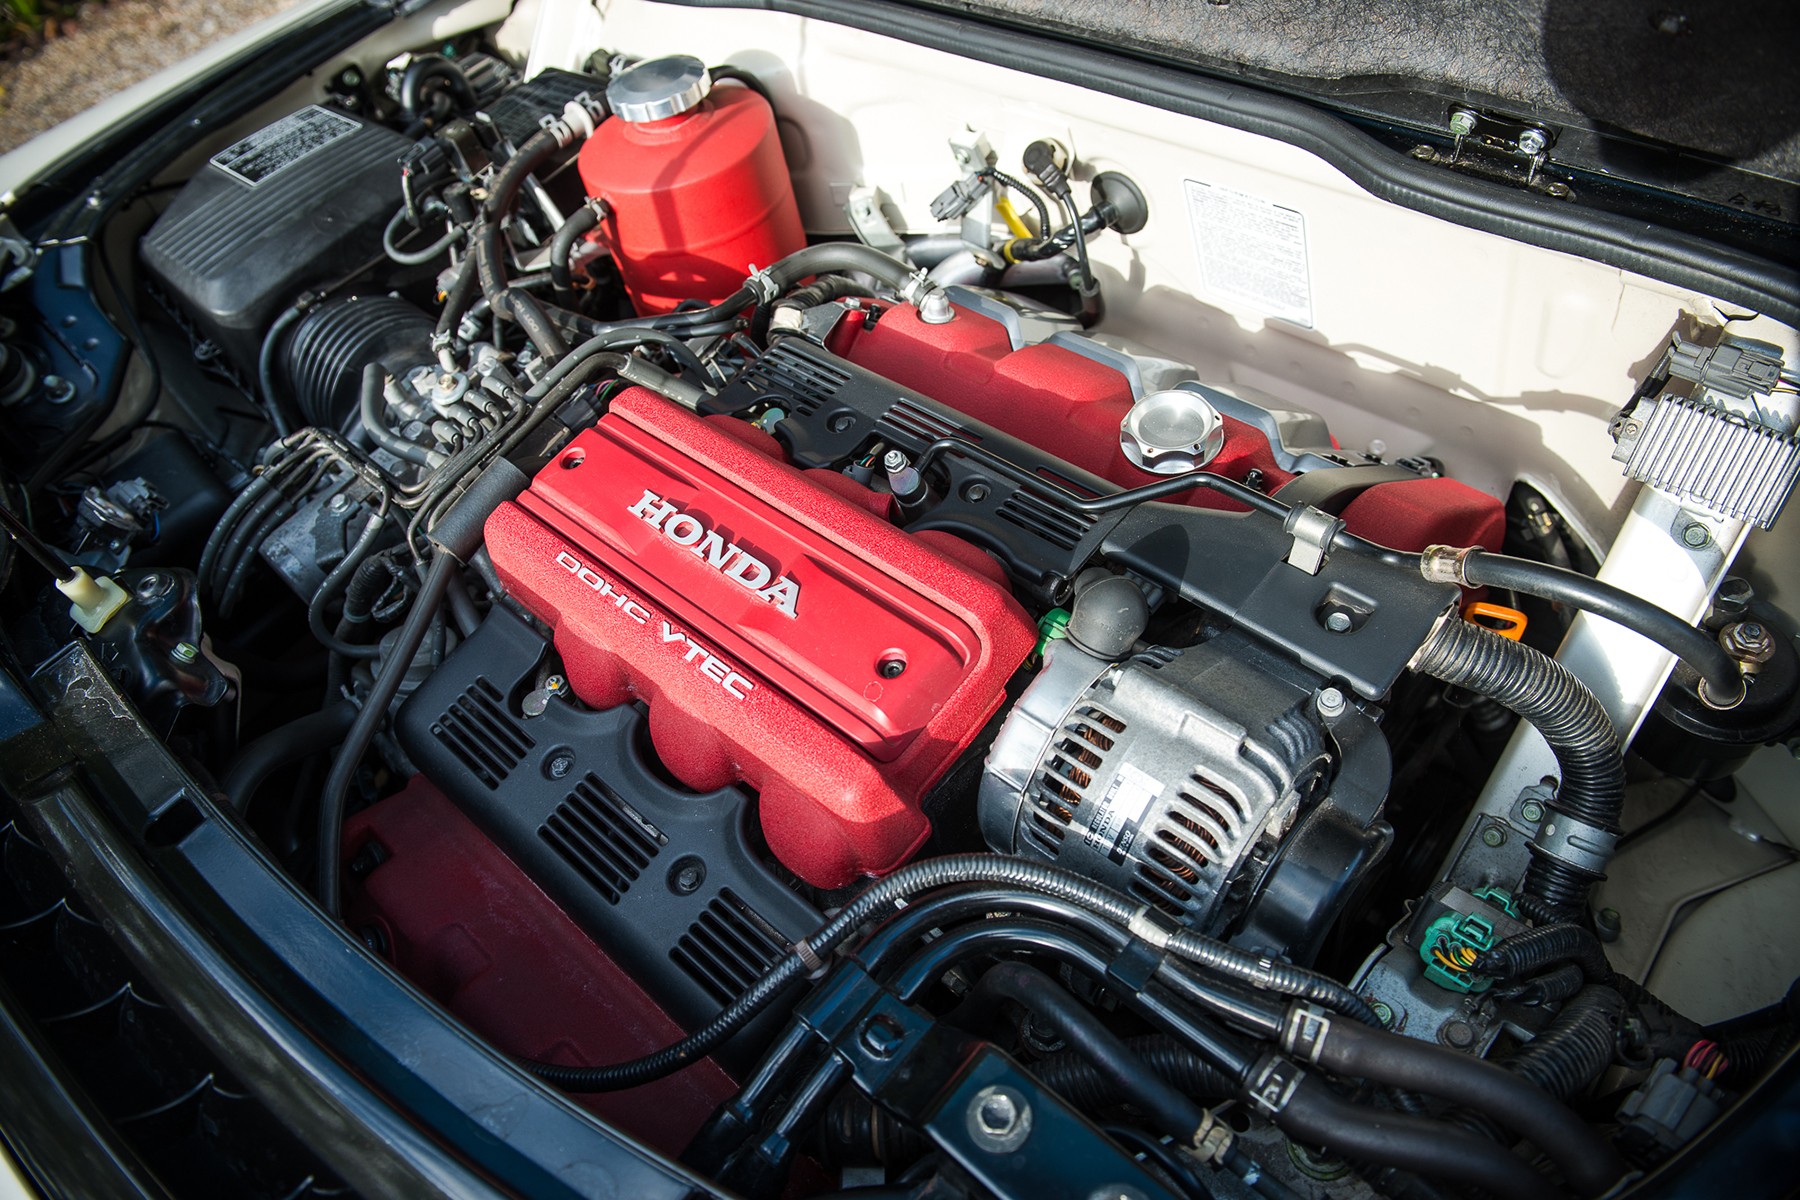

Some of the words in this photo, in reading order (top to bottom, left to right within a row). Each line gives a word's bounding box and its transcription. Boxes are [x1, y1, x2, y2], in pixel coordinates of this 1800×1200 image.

[626, 488, 800, 619] HONDA
[555, 551, 651, 624] DOHC
[661, 620, 754, 700] VTEC
[1092, 809, 1115, 849] HONDA
[1115, 829, 1132, 855] DENSO
